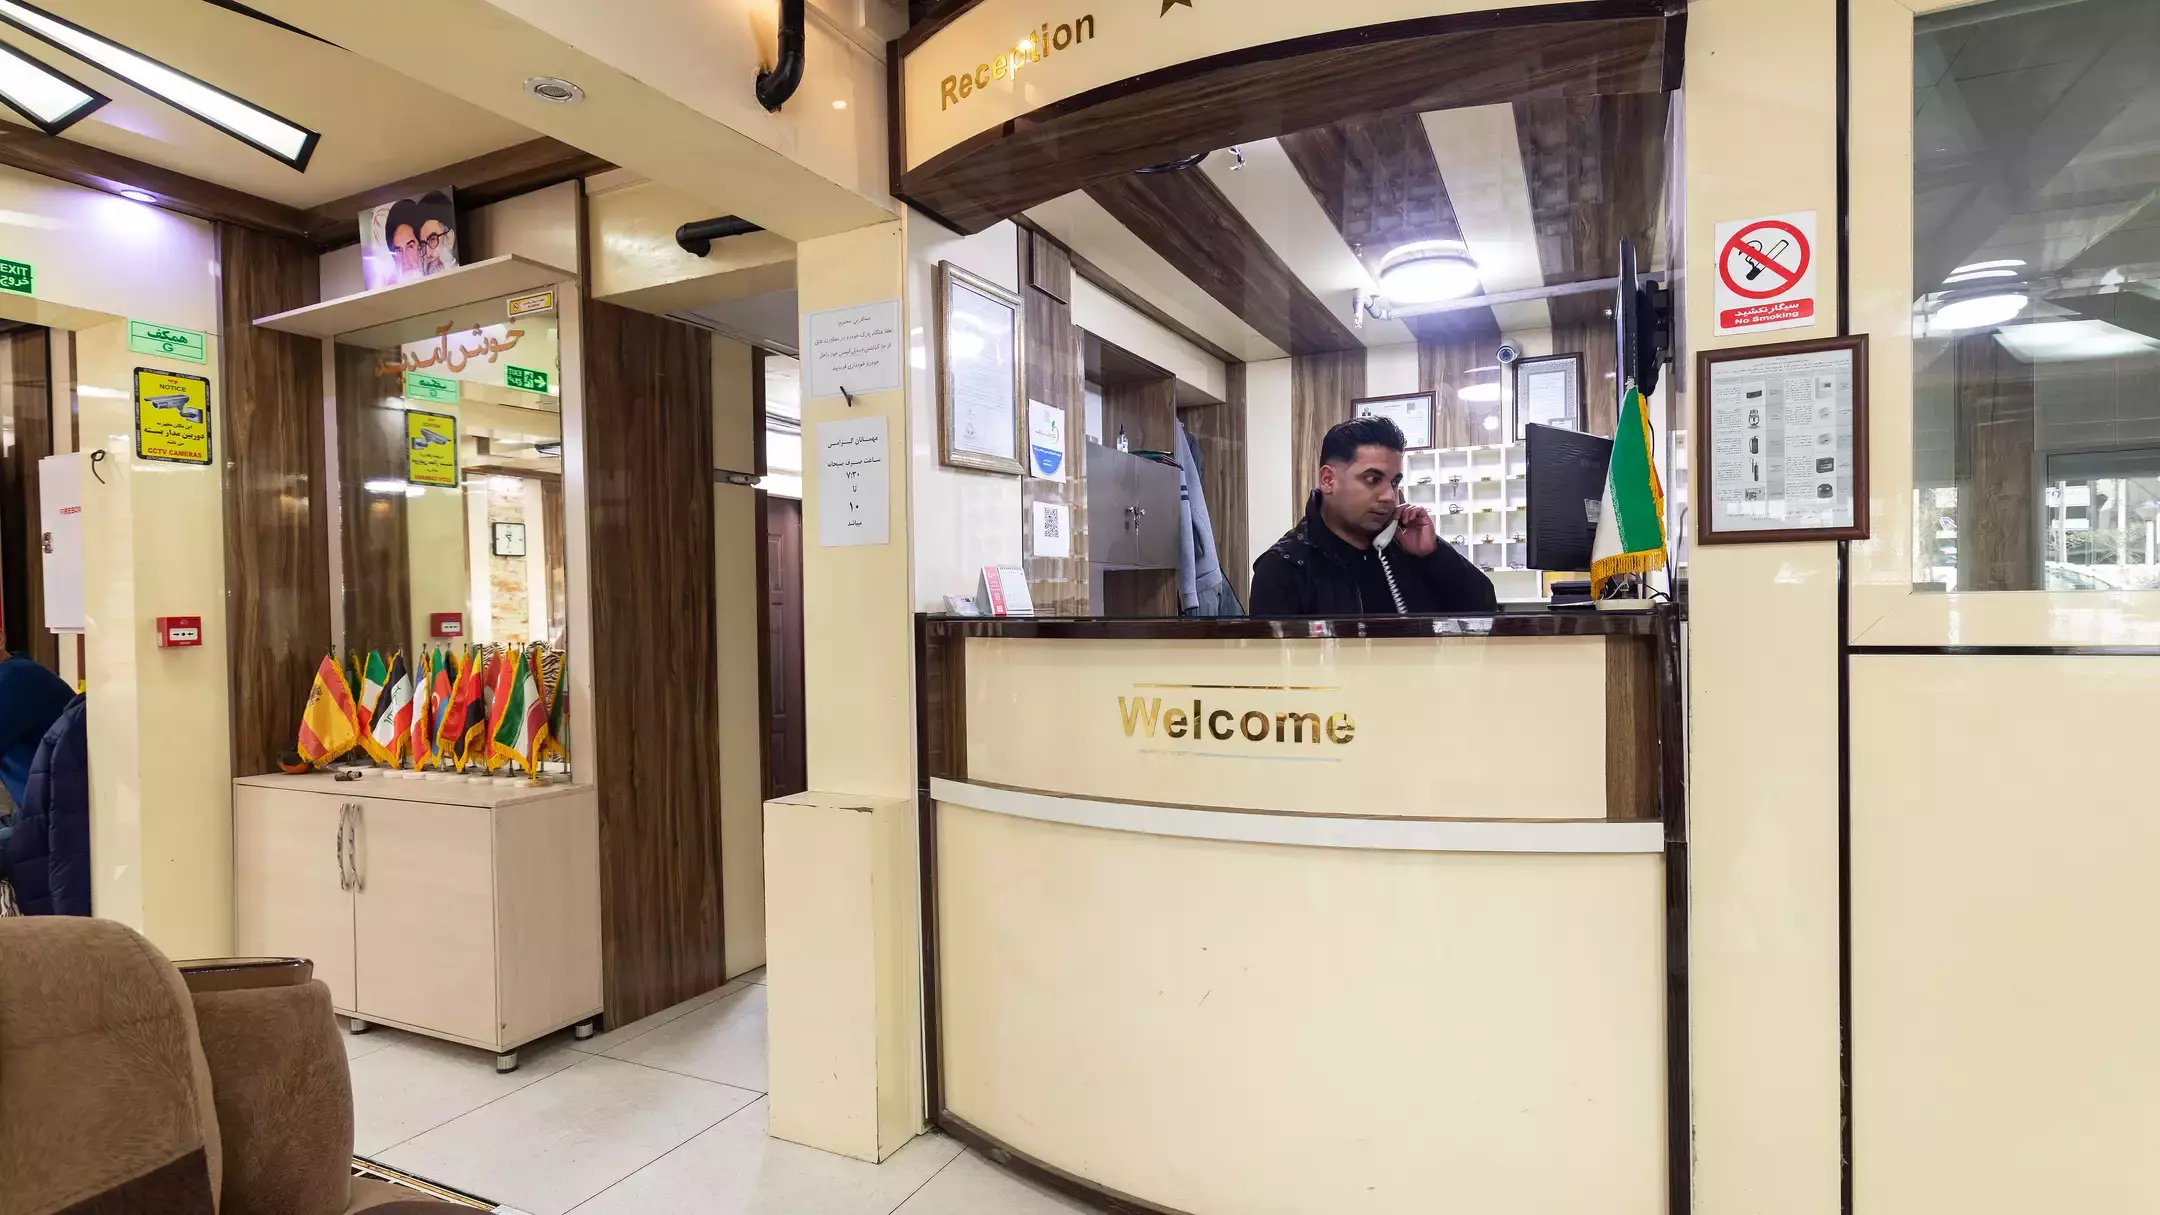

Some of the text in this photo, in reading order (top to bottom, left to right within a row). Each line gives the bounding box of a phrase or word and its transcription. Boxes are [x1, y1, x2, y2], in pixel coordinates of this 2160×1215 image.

[940, 14, 1095, 112] Reception
[0, 263, 29, 277] EXIT
[0, 275, 30, 287] خروج
[1734, 302, 1799, 318] سیگار نکشید
[1752, 311, 1799, 323] Smoking
[147, 328, 188, 344] همکف
[163, 342, 174, 352] G
[375, 316, 525, 386] خوش آمدید
[159, 383, 187, 392] NOTICE
[144, 427, 205, 440] دوربین مدار بسته
[855, 436, 878, 446] مهمانان
[148, 447, 202, 459] CCTV CAMERAS
[827, 460, 844, 468] صبحانه
[845, 458, 863, 467] صرف
[852, 485, 858, 493] تا
[849, 501, 860, 512] ۱۰
[1117, 696, 1356, 745] Welcome
